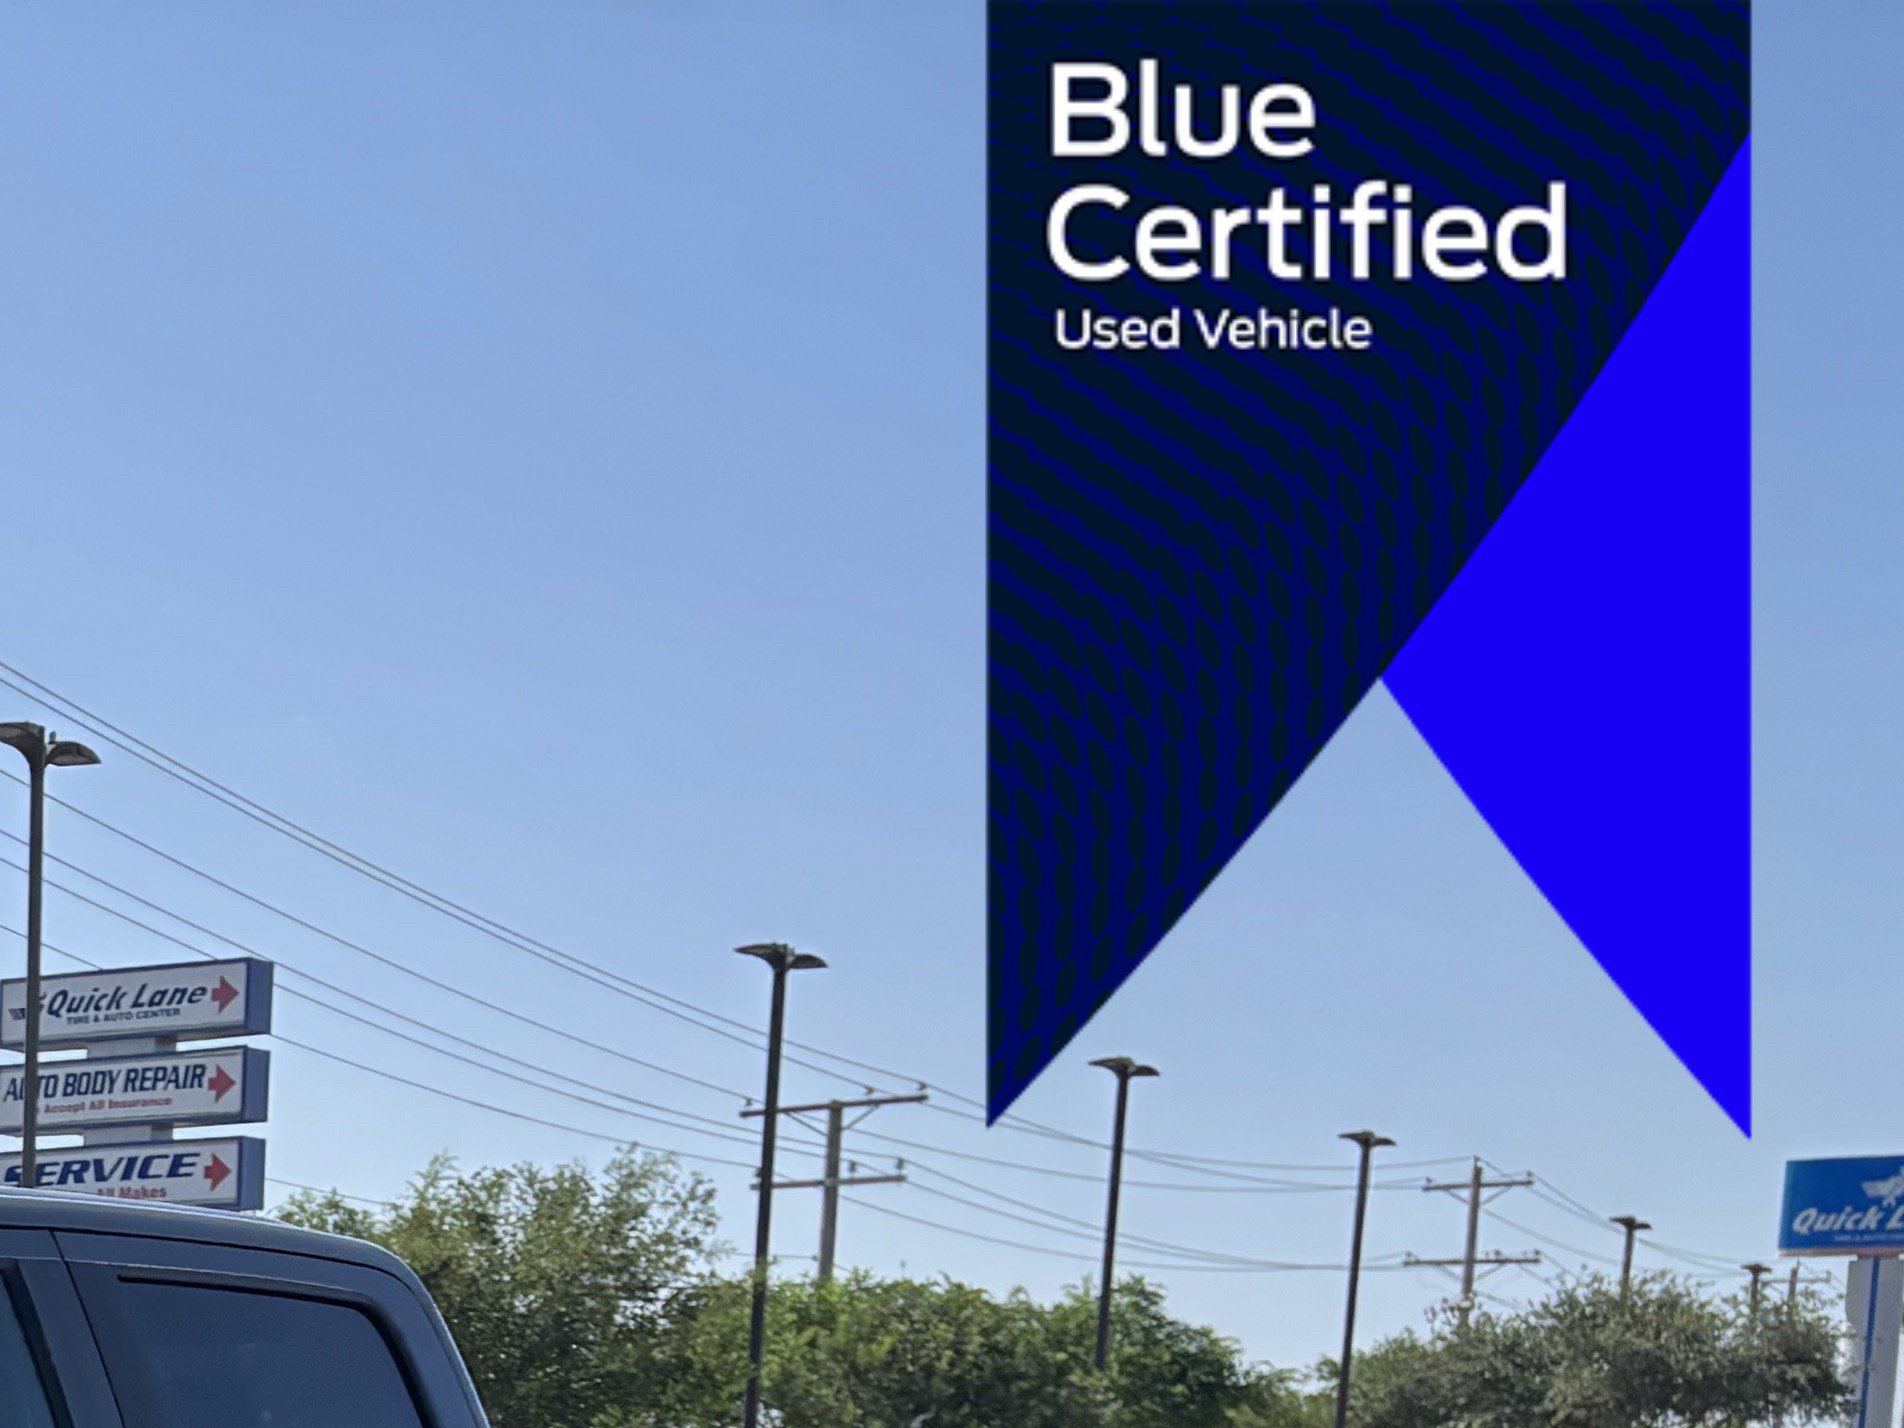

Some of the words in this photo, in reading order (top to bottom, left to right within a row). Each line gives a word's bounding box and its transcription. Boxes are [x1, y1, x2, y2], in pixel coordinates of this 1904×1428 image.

[47, 985, 129, 1018] Quick
[130, 982, 208, 1009] Lane
[135, 1007, 181, 1020] CENTER
[62, 1067, 122, 1098] BODY
[124, 1063, 207, 1092] REPAIR
[1792, 1205, 1885, 1236] Quick
